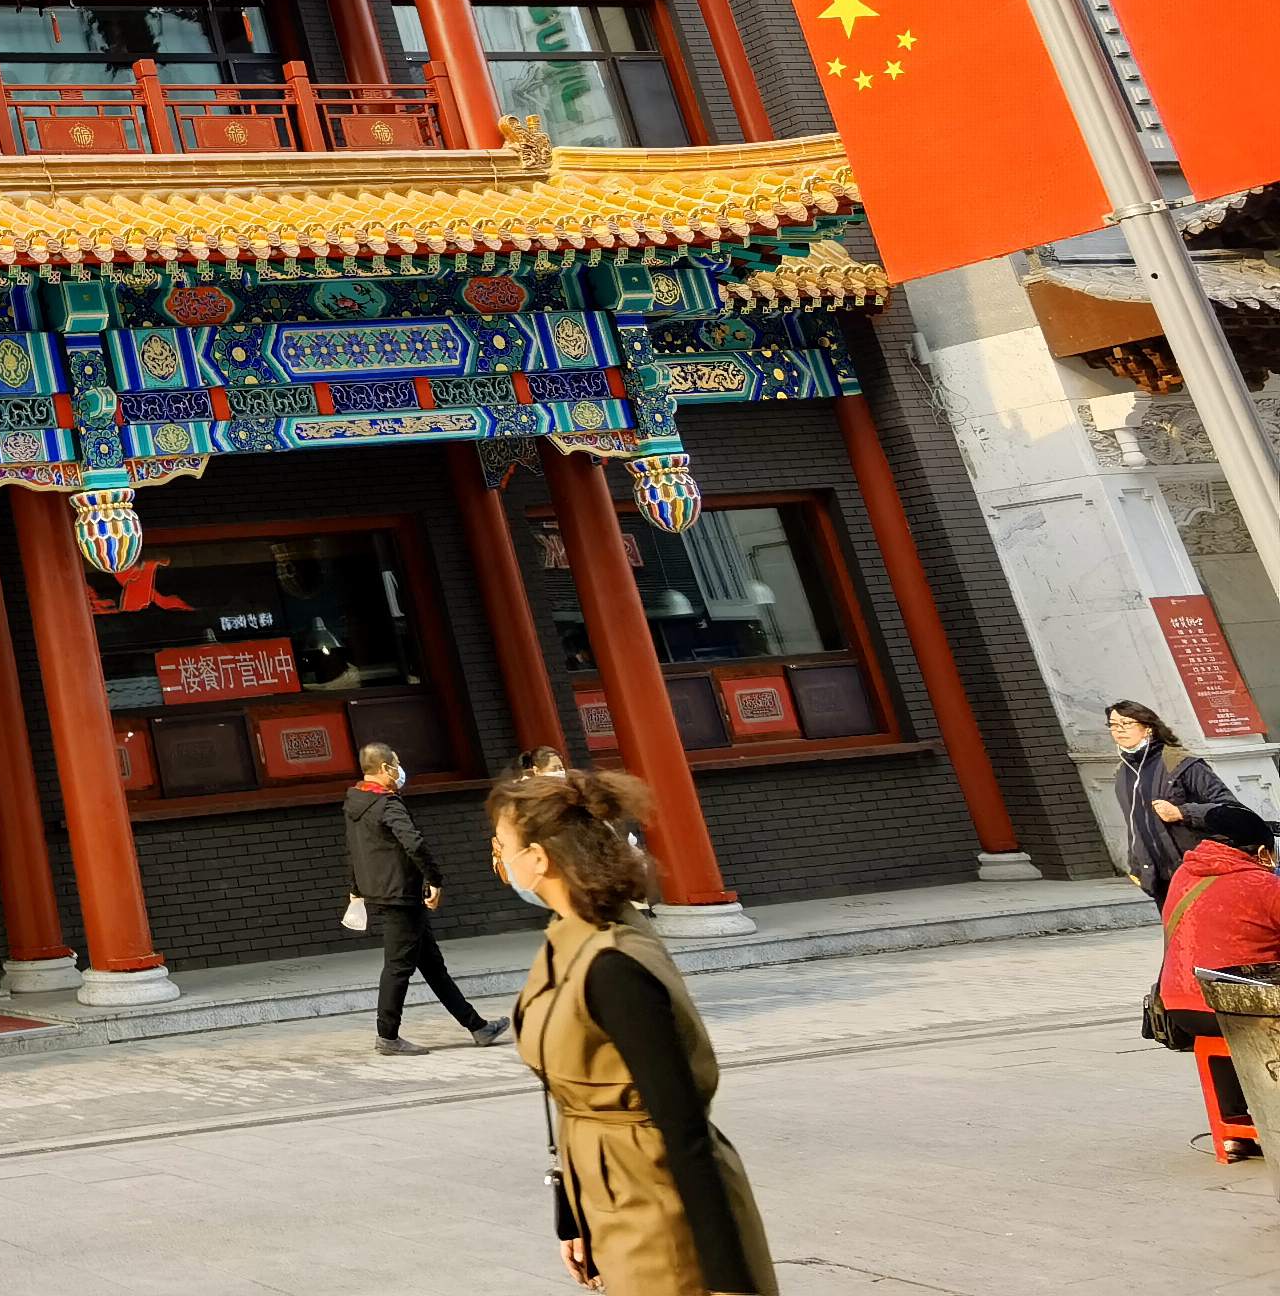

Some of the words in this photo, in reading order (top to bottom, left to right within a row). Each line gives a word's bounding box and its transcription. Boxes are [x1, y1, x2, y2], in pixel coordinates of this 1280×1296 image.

[160, 646, 294, 695] 二楼餐厅营业中
